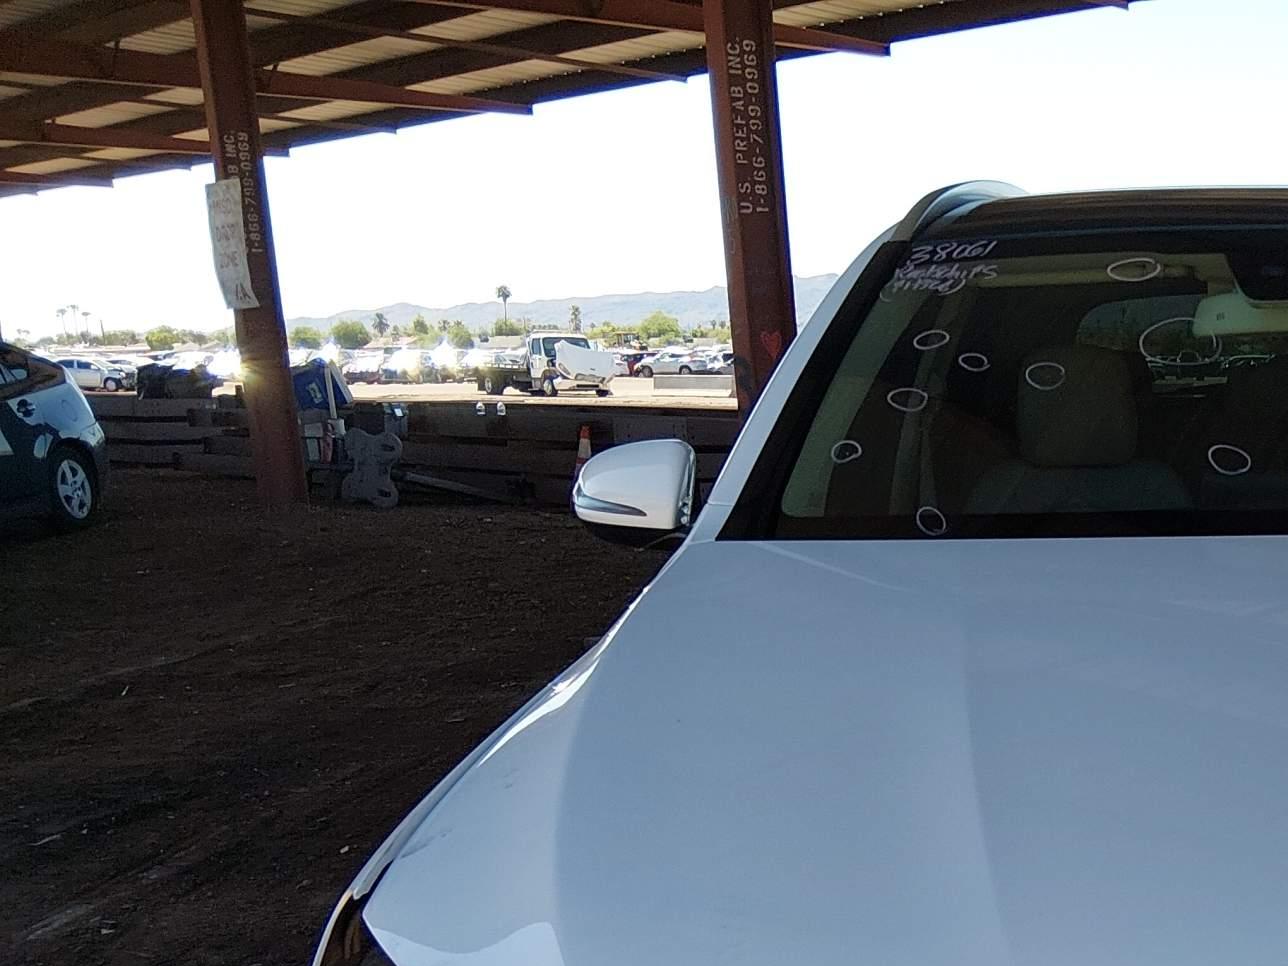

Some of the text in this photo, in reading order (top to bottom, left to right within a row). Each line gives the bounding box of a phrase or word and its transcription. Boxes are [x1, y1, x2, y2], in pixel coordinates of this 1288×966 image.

[727, 37, 753, 214] U.S. PREFAB INC.
[743, 39, 769, 213] 1-866-799-0969
